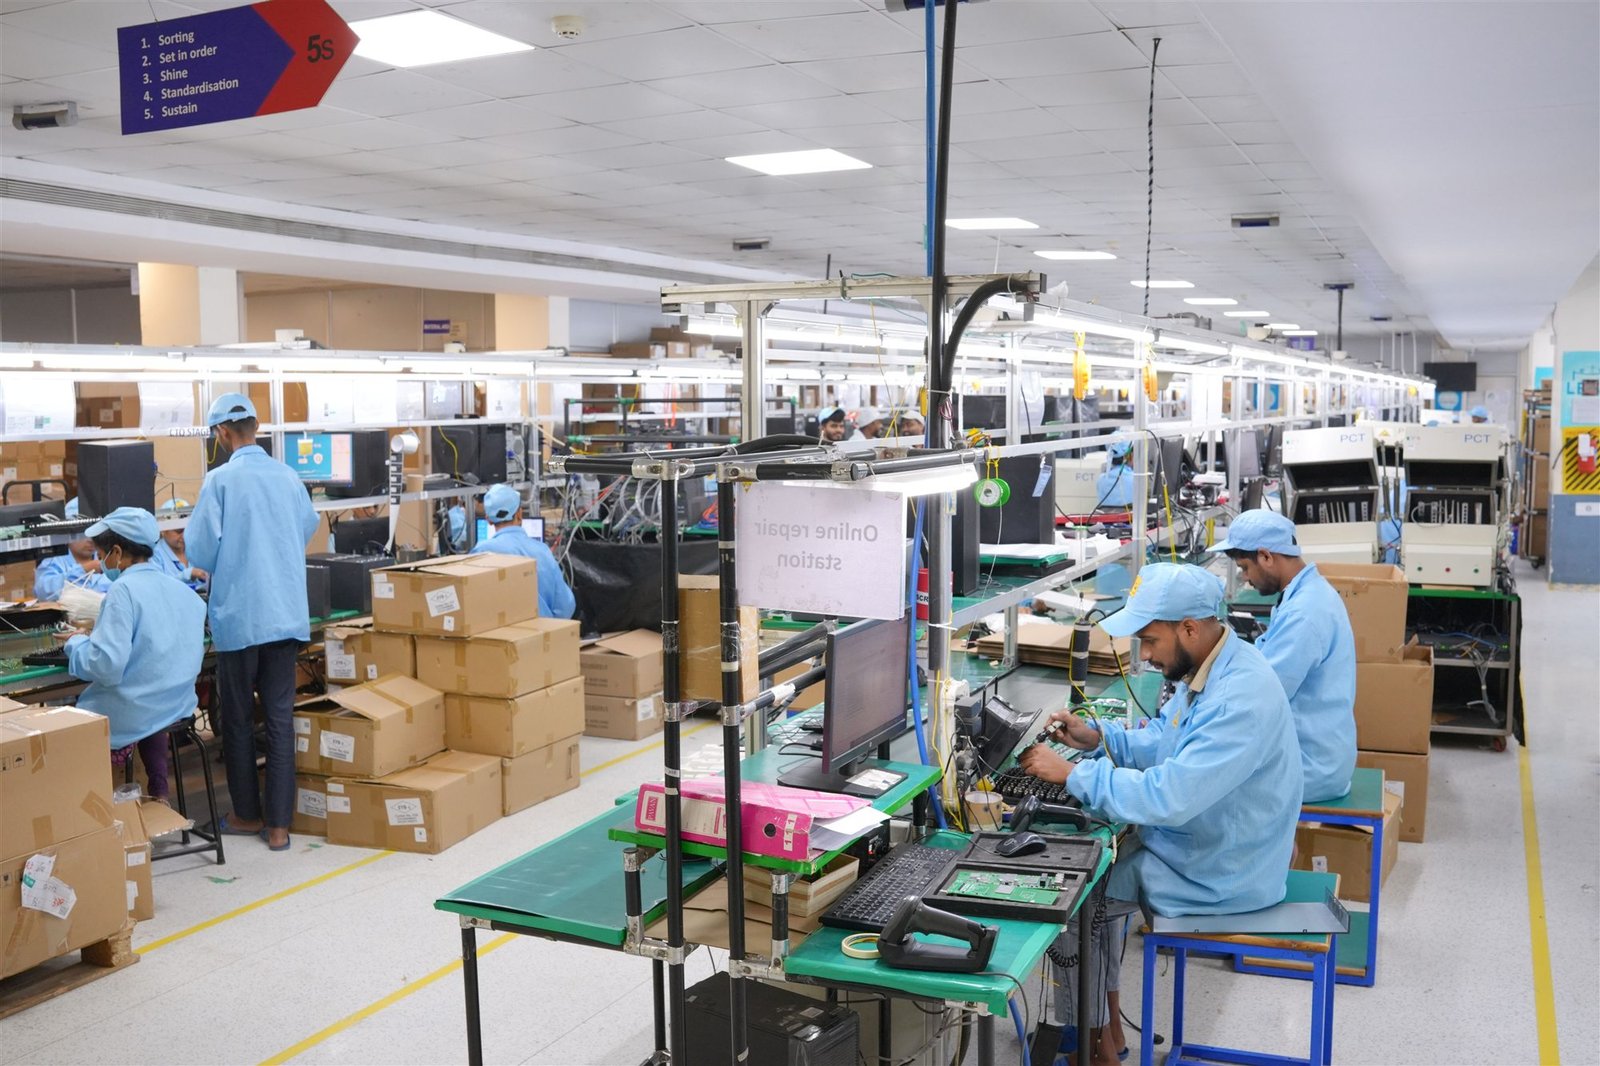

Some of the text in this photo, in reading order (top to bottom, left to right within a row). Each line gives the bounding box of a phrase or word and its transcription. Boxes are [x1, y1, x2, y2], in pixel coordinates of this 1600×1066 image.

[141, 31, 195, 49] 1. Sorting
[307, 34, 335, 63] 5S
[141, 45, 218, 67] 2. Set in order
[142, 68, 188, 84] 3. Shine
[143, 78, 239, 102] 4. Standardisation
[144, 102, 198, 120] 5. Sustain
[1340, 433, 1365, 443] PCT
[1464, 434, 1491, 444] PCT
